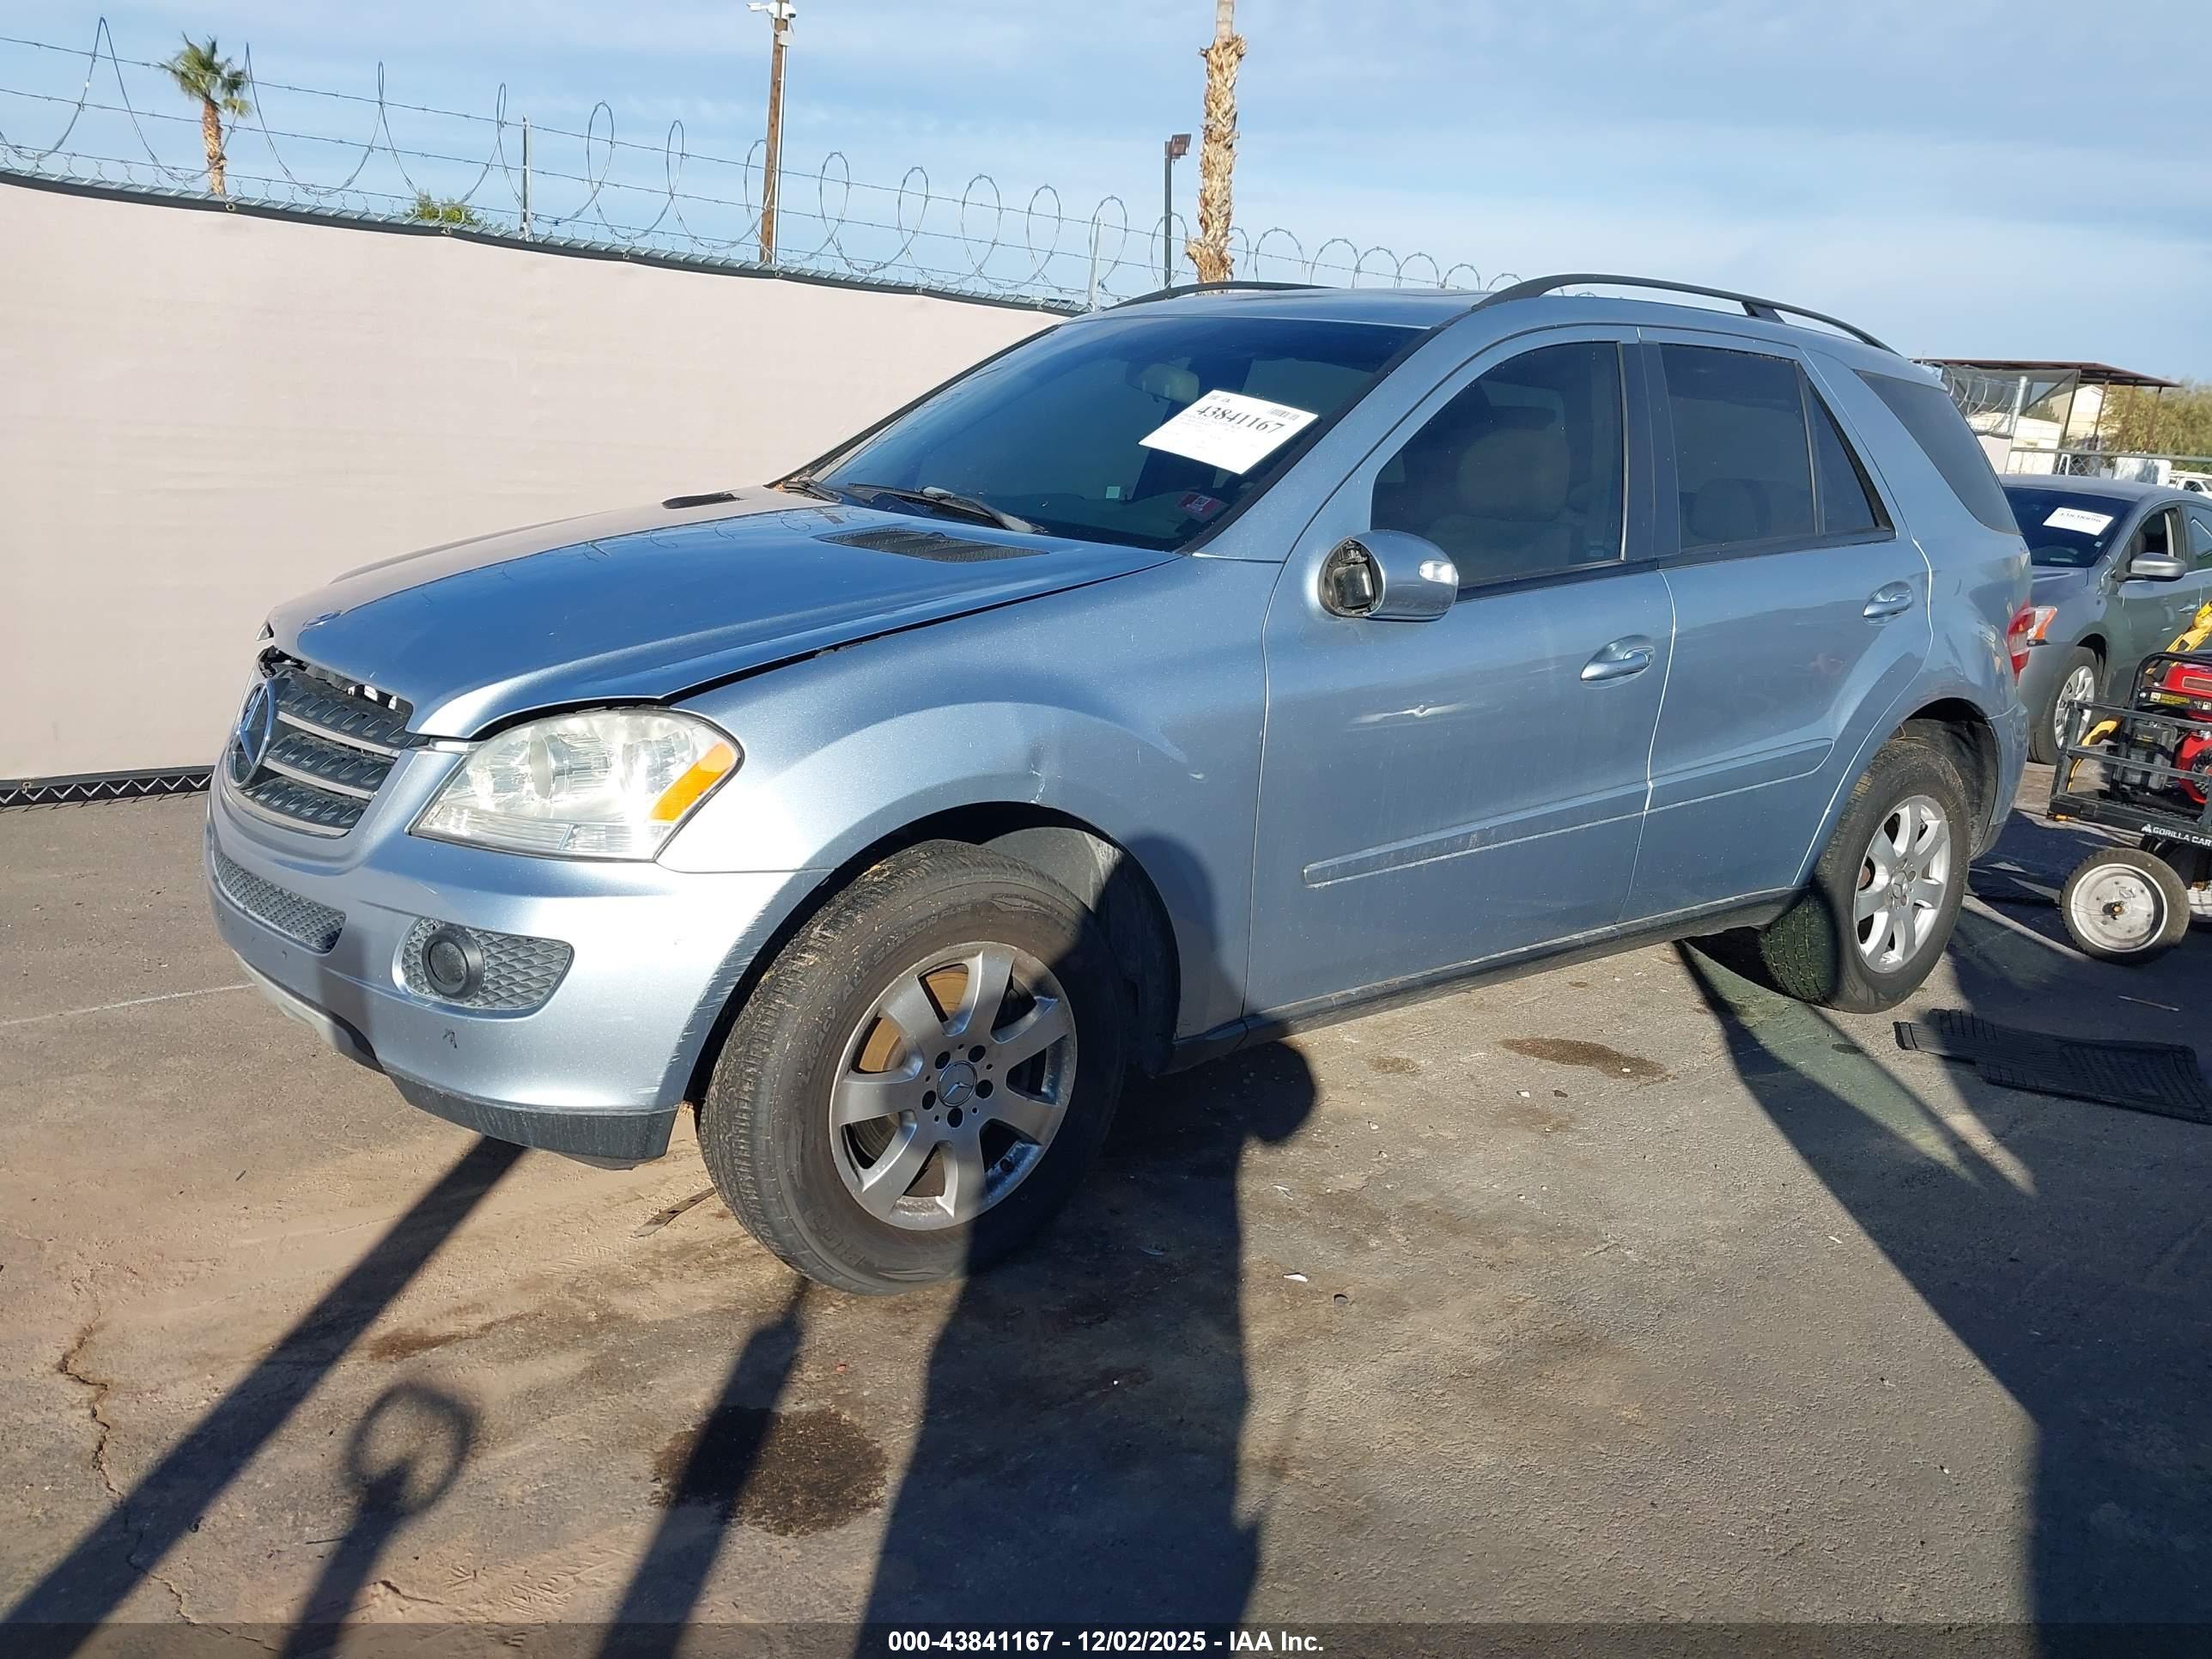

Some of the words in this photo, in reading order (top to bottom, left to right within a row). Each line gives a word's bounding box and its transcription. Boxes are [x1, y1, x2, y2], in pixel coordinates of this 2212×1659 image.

[1196, 404, 1285, 434] 43841167
[2152, 826, 2190, 842] GORILLA
[2191, 836, 2212, 848] CAR
